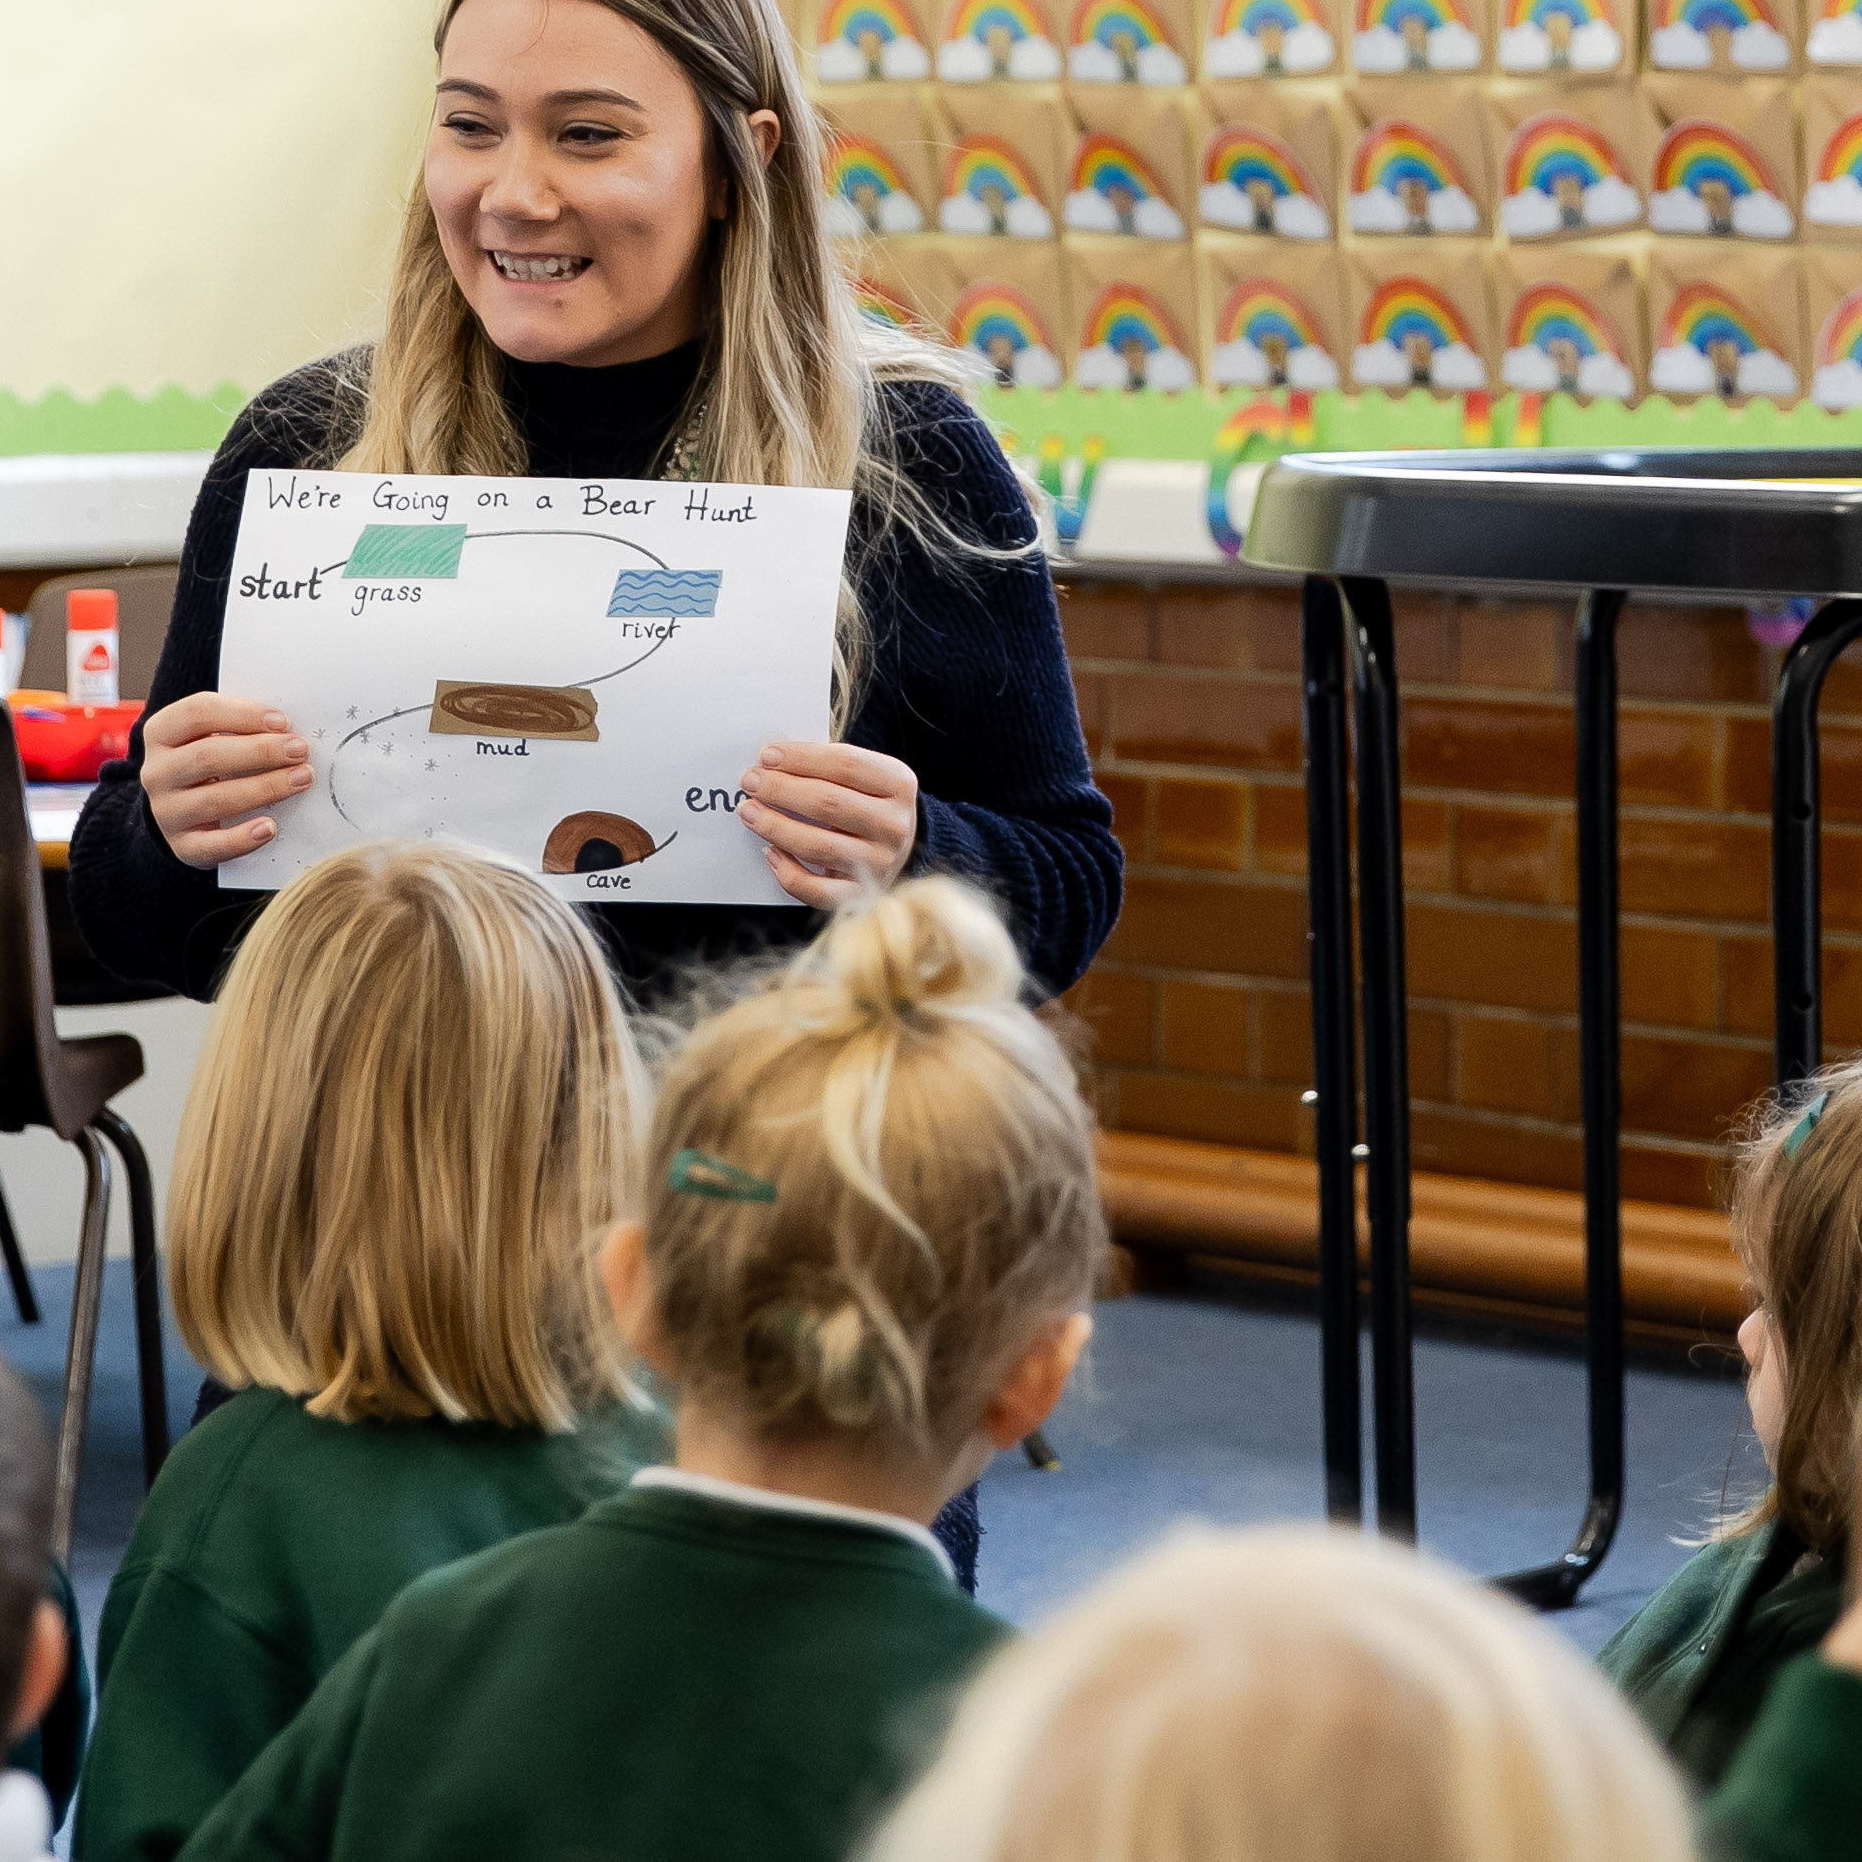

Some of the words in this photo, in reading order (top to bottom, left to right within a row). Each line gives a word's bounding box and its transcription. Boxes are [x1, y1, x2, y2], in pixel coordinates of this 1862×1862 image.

[268, 476, 341, 511] We're
[373, 481, 449, 520] Going
[478, 492, 509, 508] on
[536, 496, 554, 510] a
[581, 485, 656, 517] Bear
[684, 488, 758, 524] Hunt
[240, 562, 323, 602] start
[352, 581, 422, 616] grass
[622, 619, 681, 639] river
[476, 738, 530, 757] mud
[586, 874, 632, 889] cave
